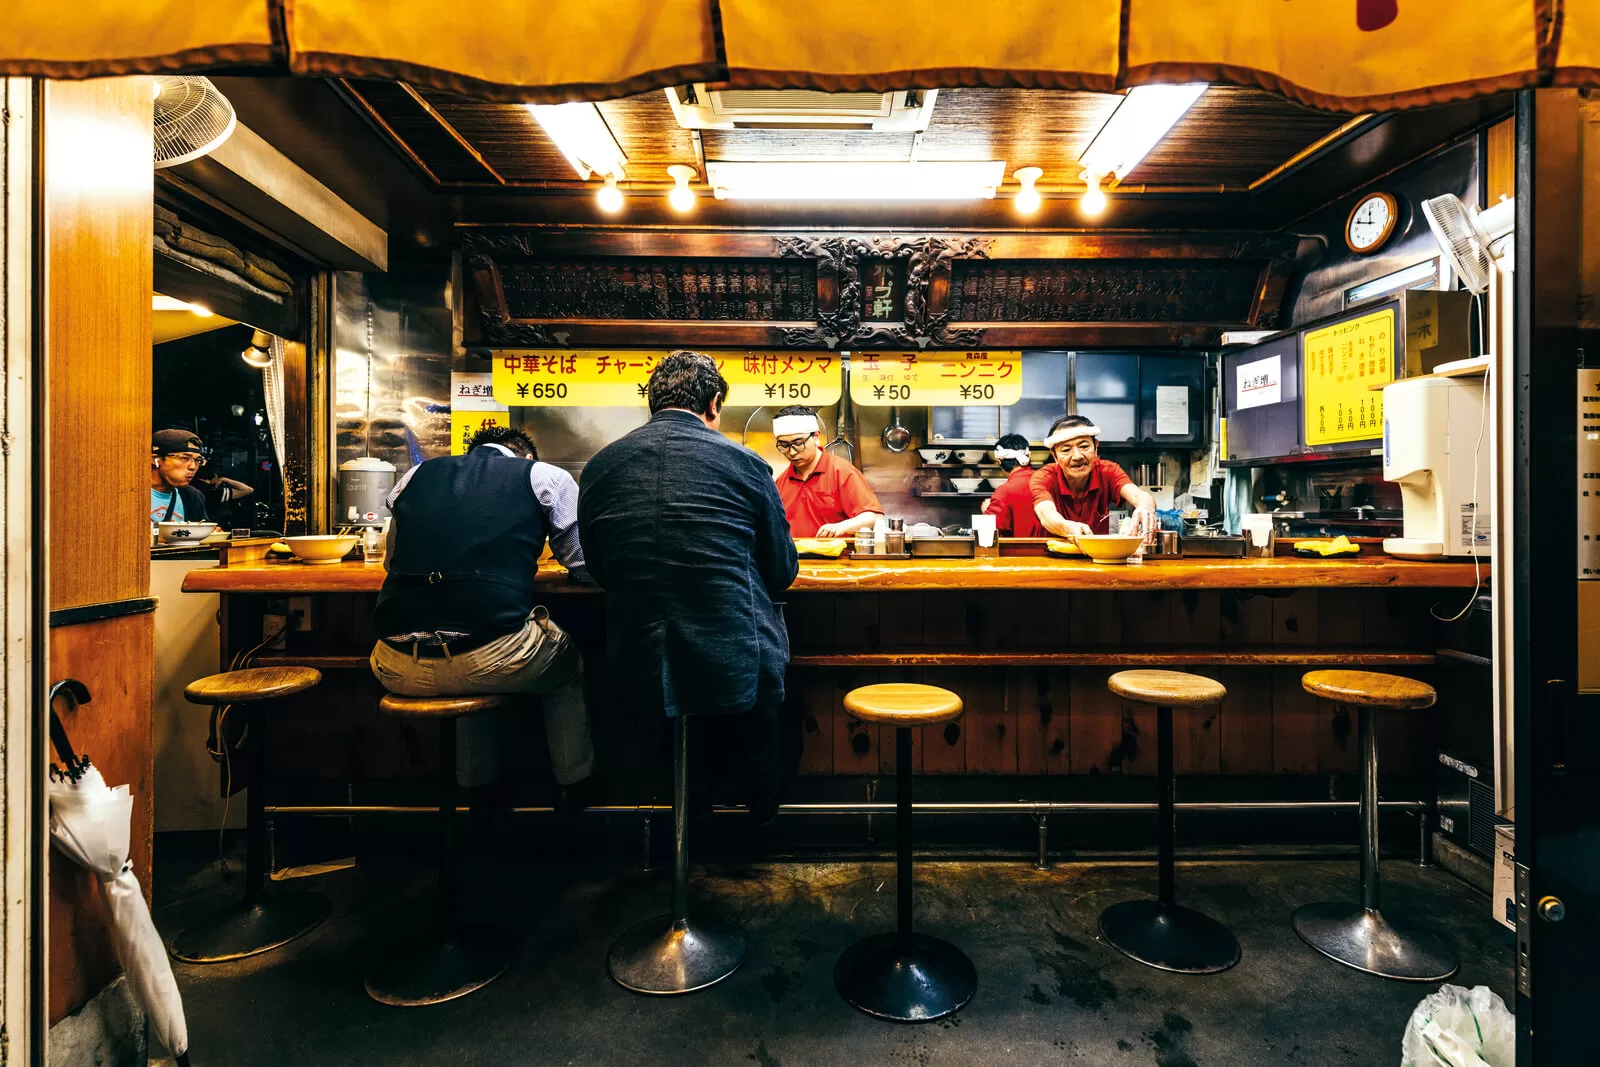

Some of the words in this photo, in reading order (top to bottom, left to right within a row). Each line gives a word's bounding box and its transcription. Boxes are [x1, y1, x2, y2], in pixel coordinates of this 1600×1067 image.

[504, 354, 577, 375] 中華そば
[743, 355, 832, 375] 味付メンマ
[941, 361, 1013, 378] ニンニク
[517, 382, 568, 399] ¥650
[764, 383, 811, 398] ¥150
[873, 385, 911, 400] ¥50
[960, 385, 995, 400] ¥50
